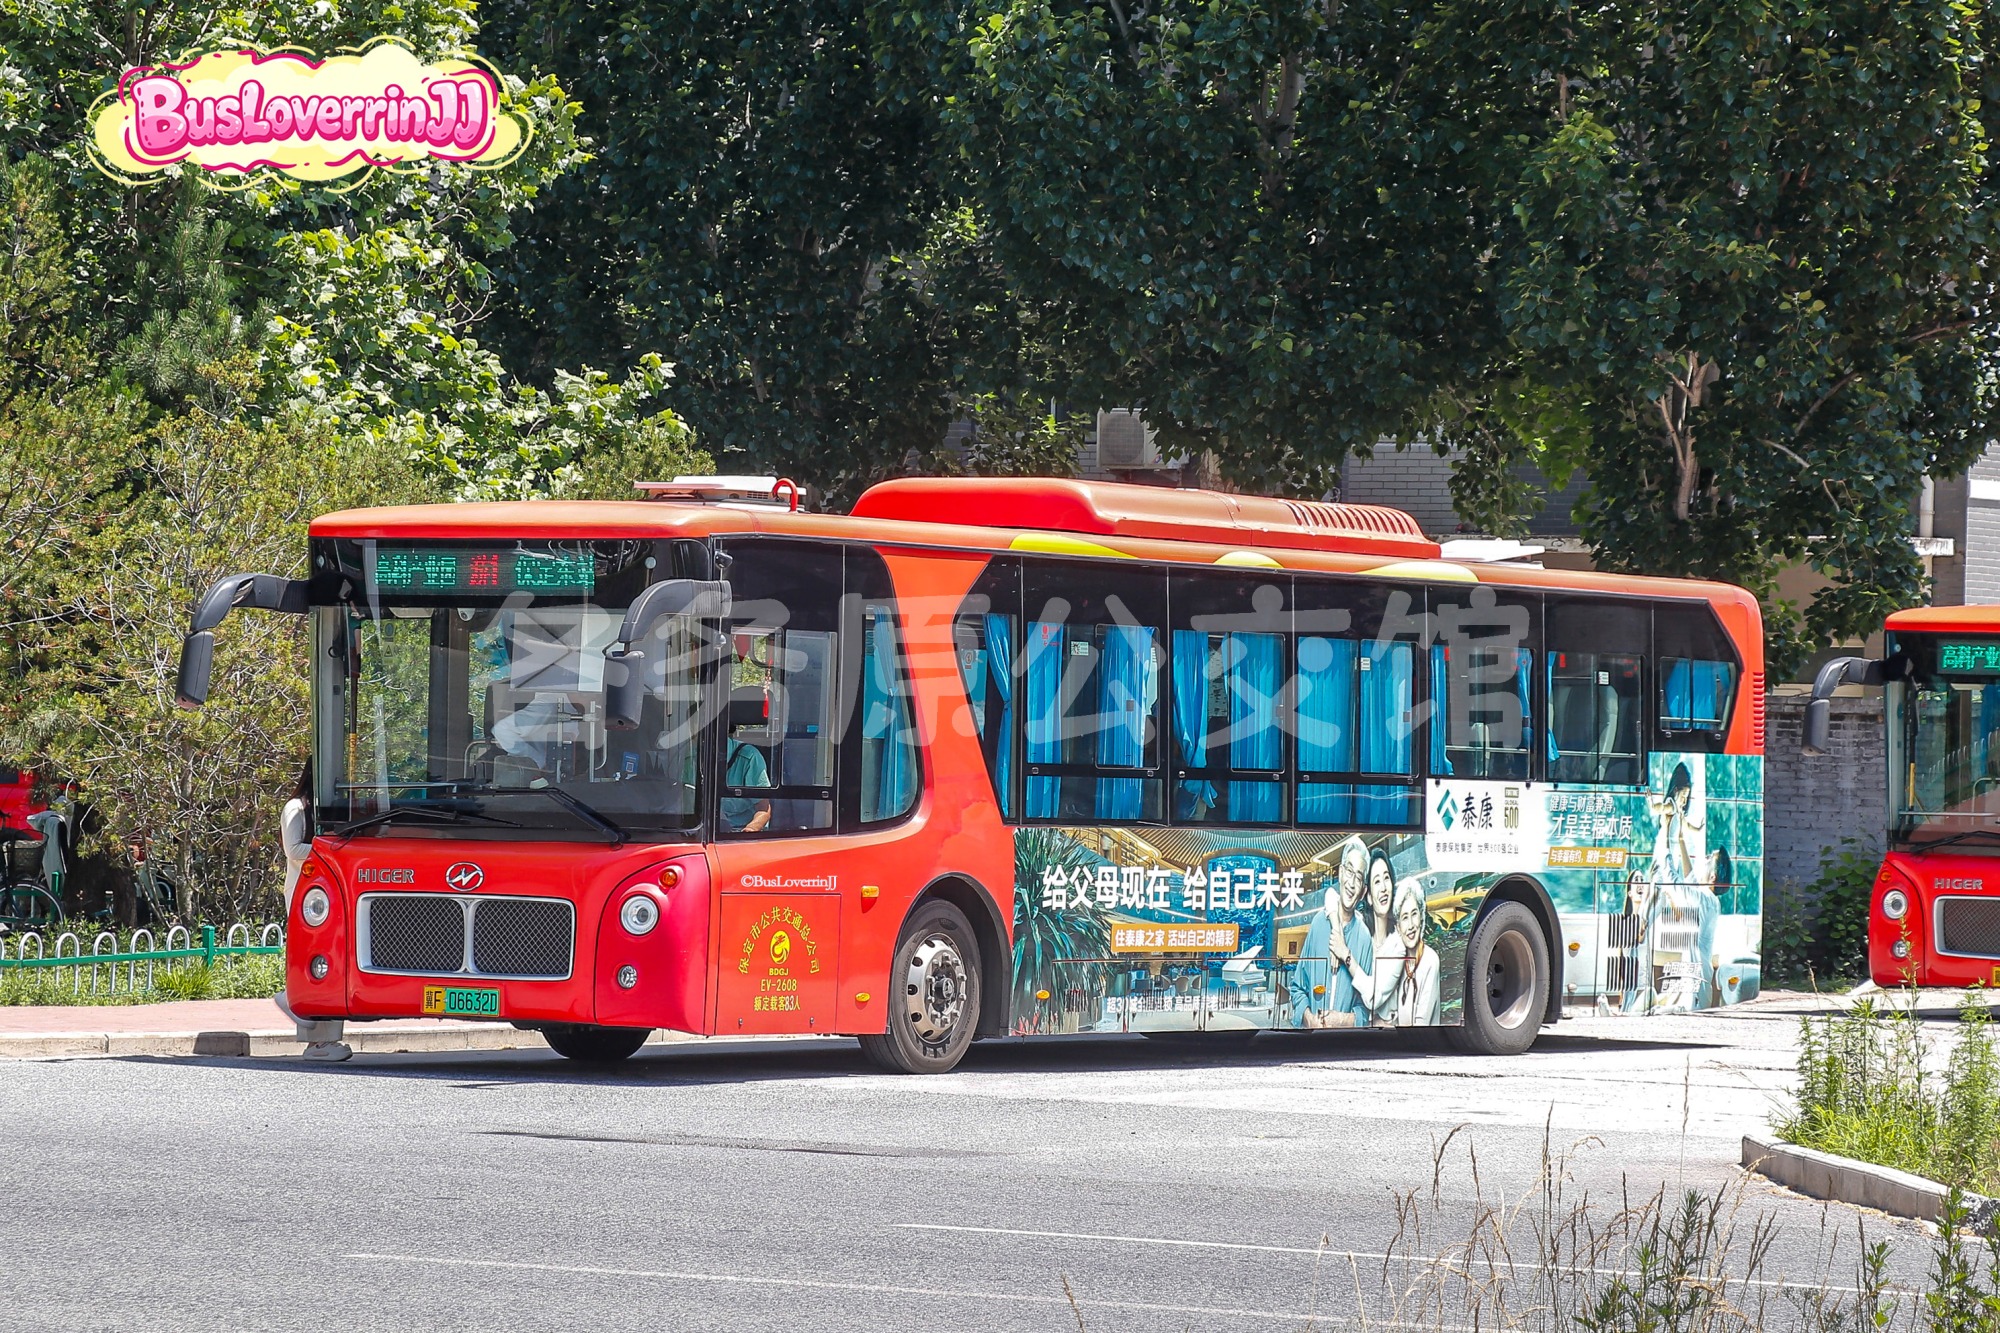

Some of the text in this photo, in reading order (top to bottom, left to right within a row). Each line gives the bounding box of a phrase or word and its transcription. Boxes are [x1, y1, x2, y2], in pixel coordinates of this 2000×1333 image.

[1942, 645, 2000, 670] 高科产业
[1461, 792, 1493, 830] 泰康
[1504, 806, 1519, 829] 500
[1550, 814, 1633, 840] 才是幸福本质
[358, 868, 415, 884] HIGER
[1934, 878, 1983, 890] HIGER
[1042, 864, 1305, 912] 给父母现在 给自己未来
[738, 906, 820, 975] 保定市公共交通总公司
[1115, 929, 1235, 948] 住泰康之家 活出自己的精彩
[768, 968, 789, 976] BDGJ
[760, 978, 797, 992] EV-2608
[754, 995, 801, 1012] 额定载客83人
